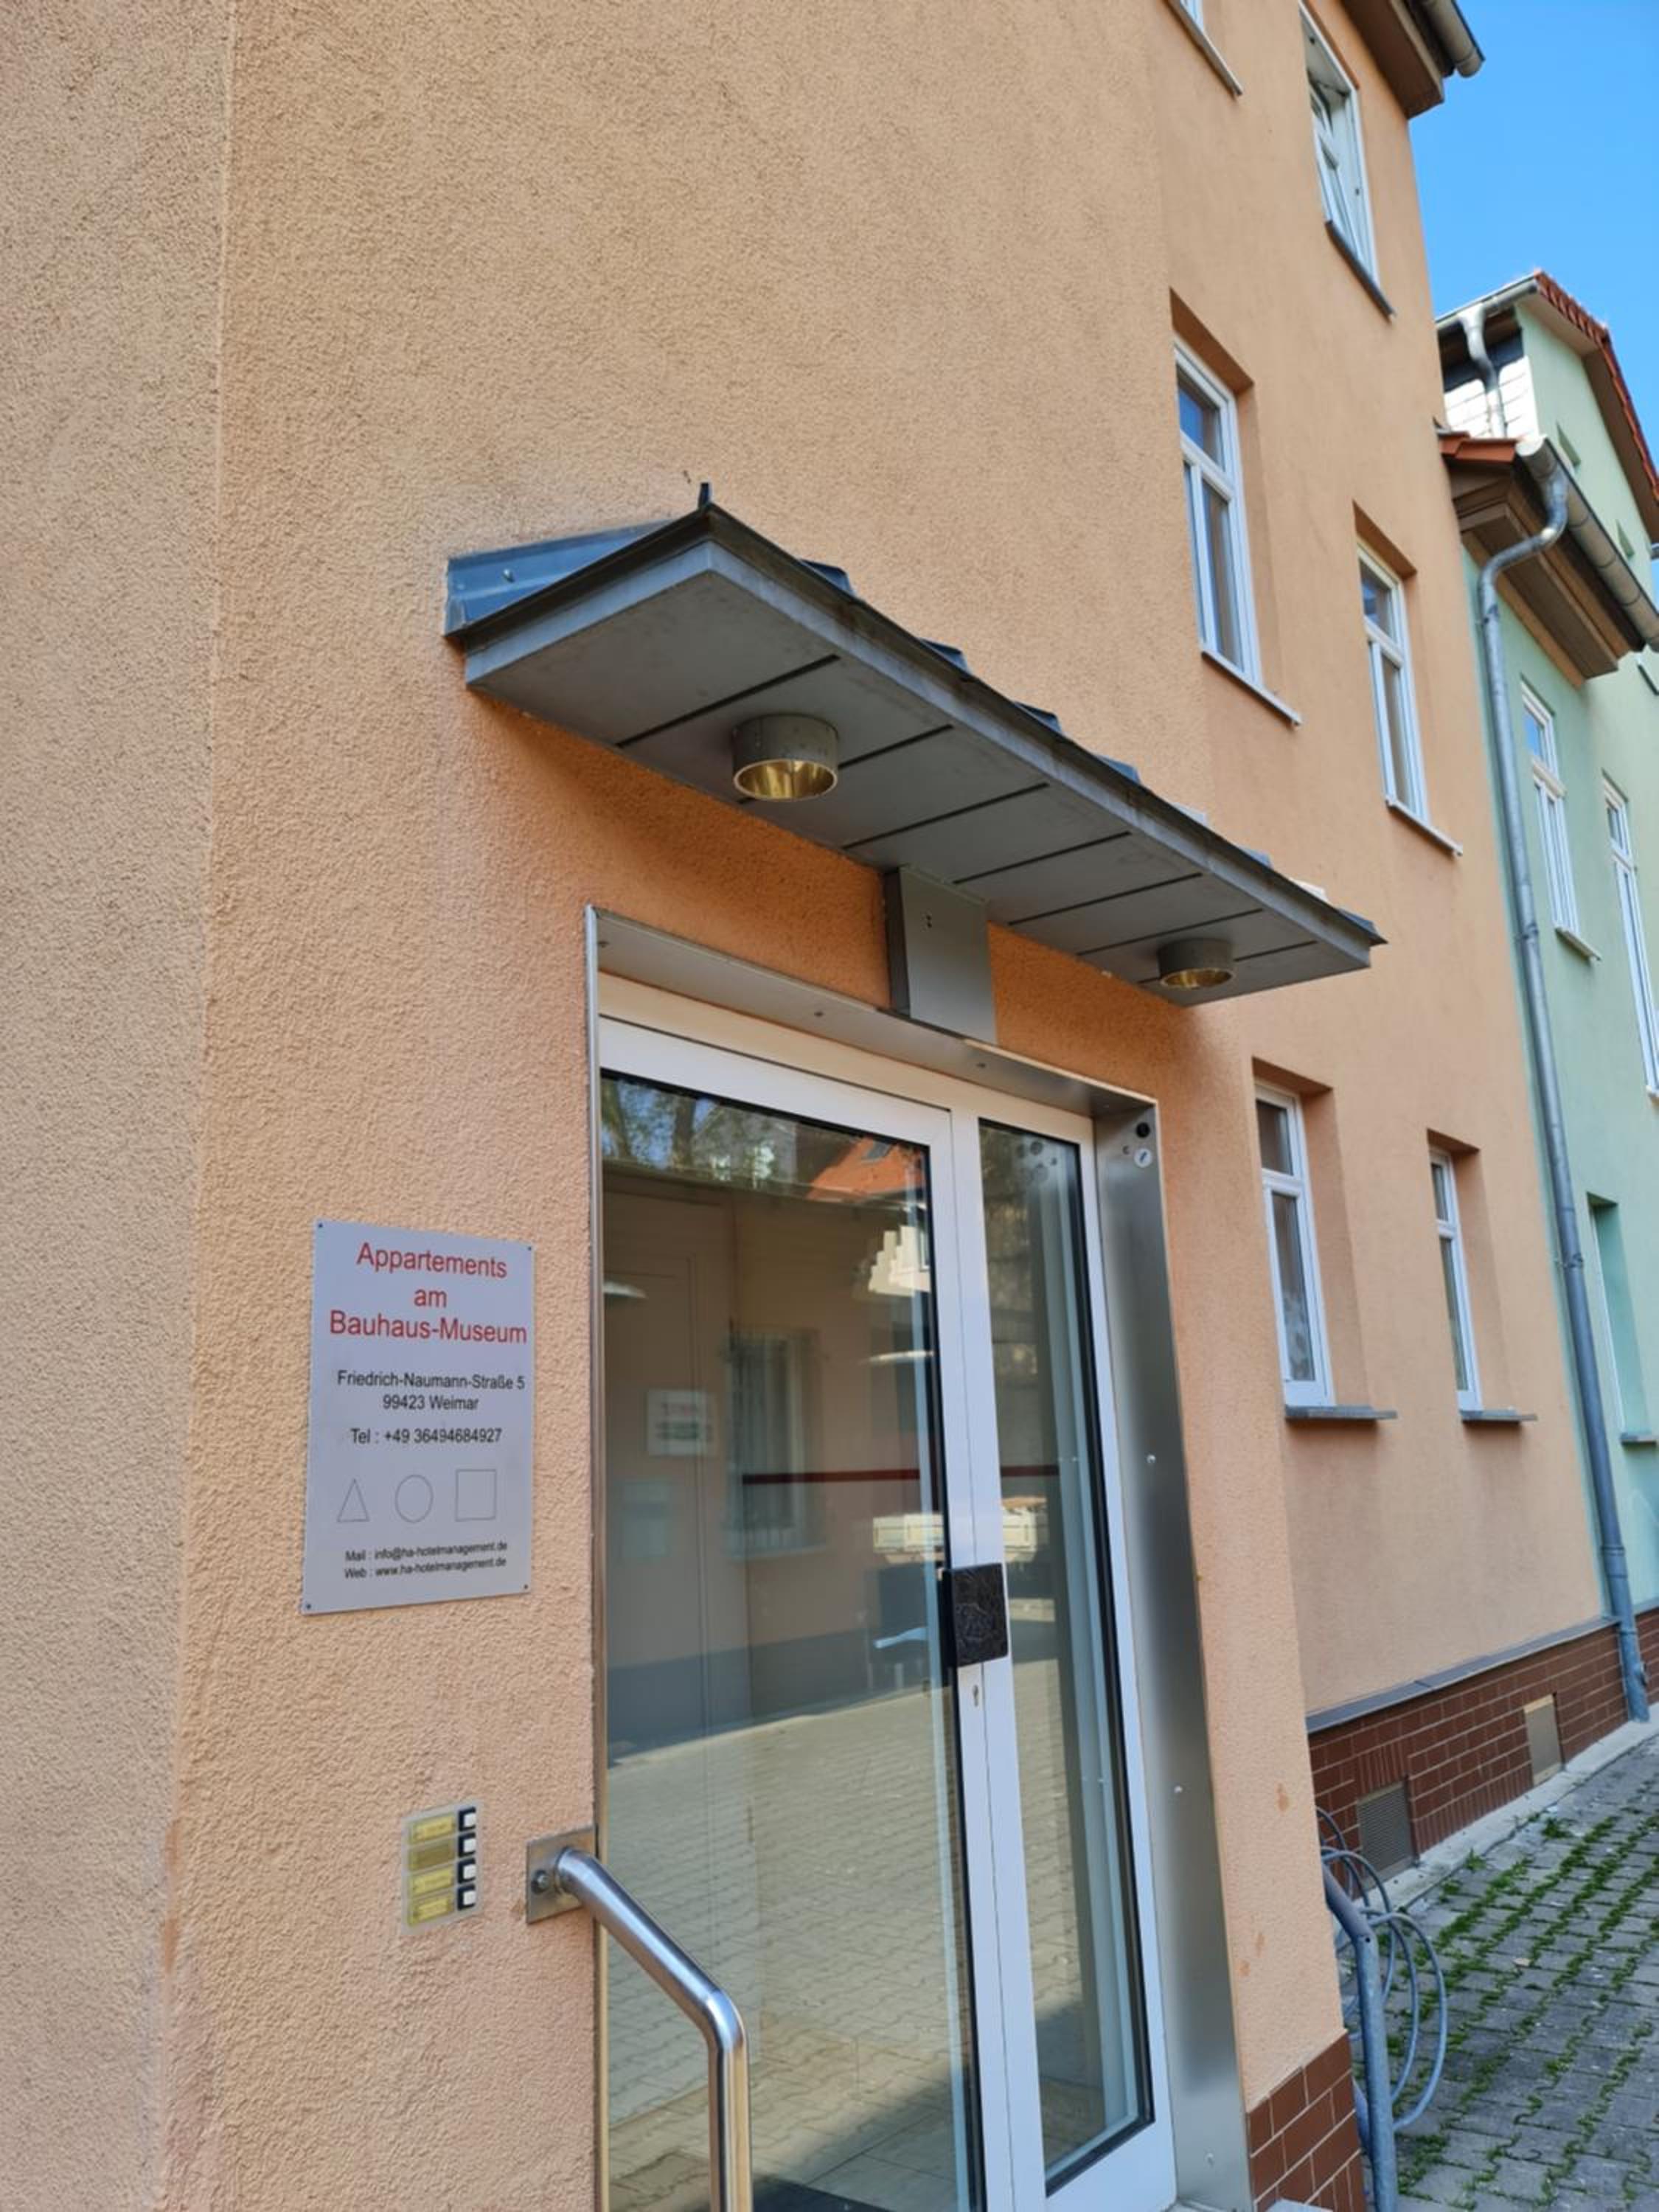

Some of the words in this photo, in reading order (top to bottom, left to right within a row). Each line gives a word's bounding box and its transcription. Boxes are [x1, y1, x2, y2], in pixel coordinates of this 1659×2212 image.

[356, 1242, 507, 1279] Appartements
[414, 1288, 448, 1308] am
[330, 1310, 527, 1343] Bauhaus-Museum
[337, 1370, 513, 1390] Friedrich-Naumann-Straße
[516, 1377, 525, 1389] 5
[383, 1394, 425, 1410] 99423
[429, 1396, 479, 1410] Weimar
[350, 1429, 371, 1444] Tel
[384, 1429, 410, 1444] +49
[345, 1550, 366, 1562] Mail
[344, 1567, 367, 1579] Web
